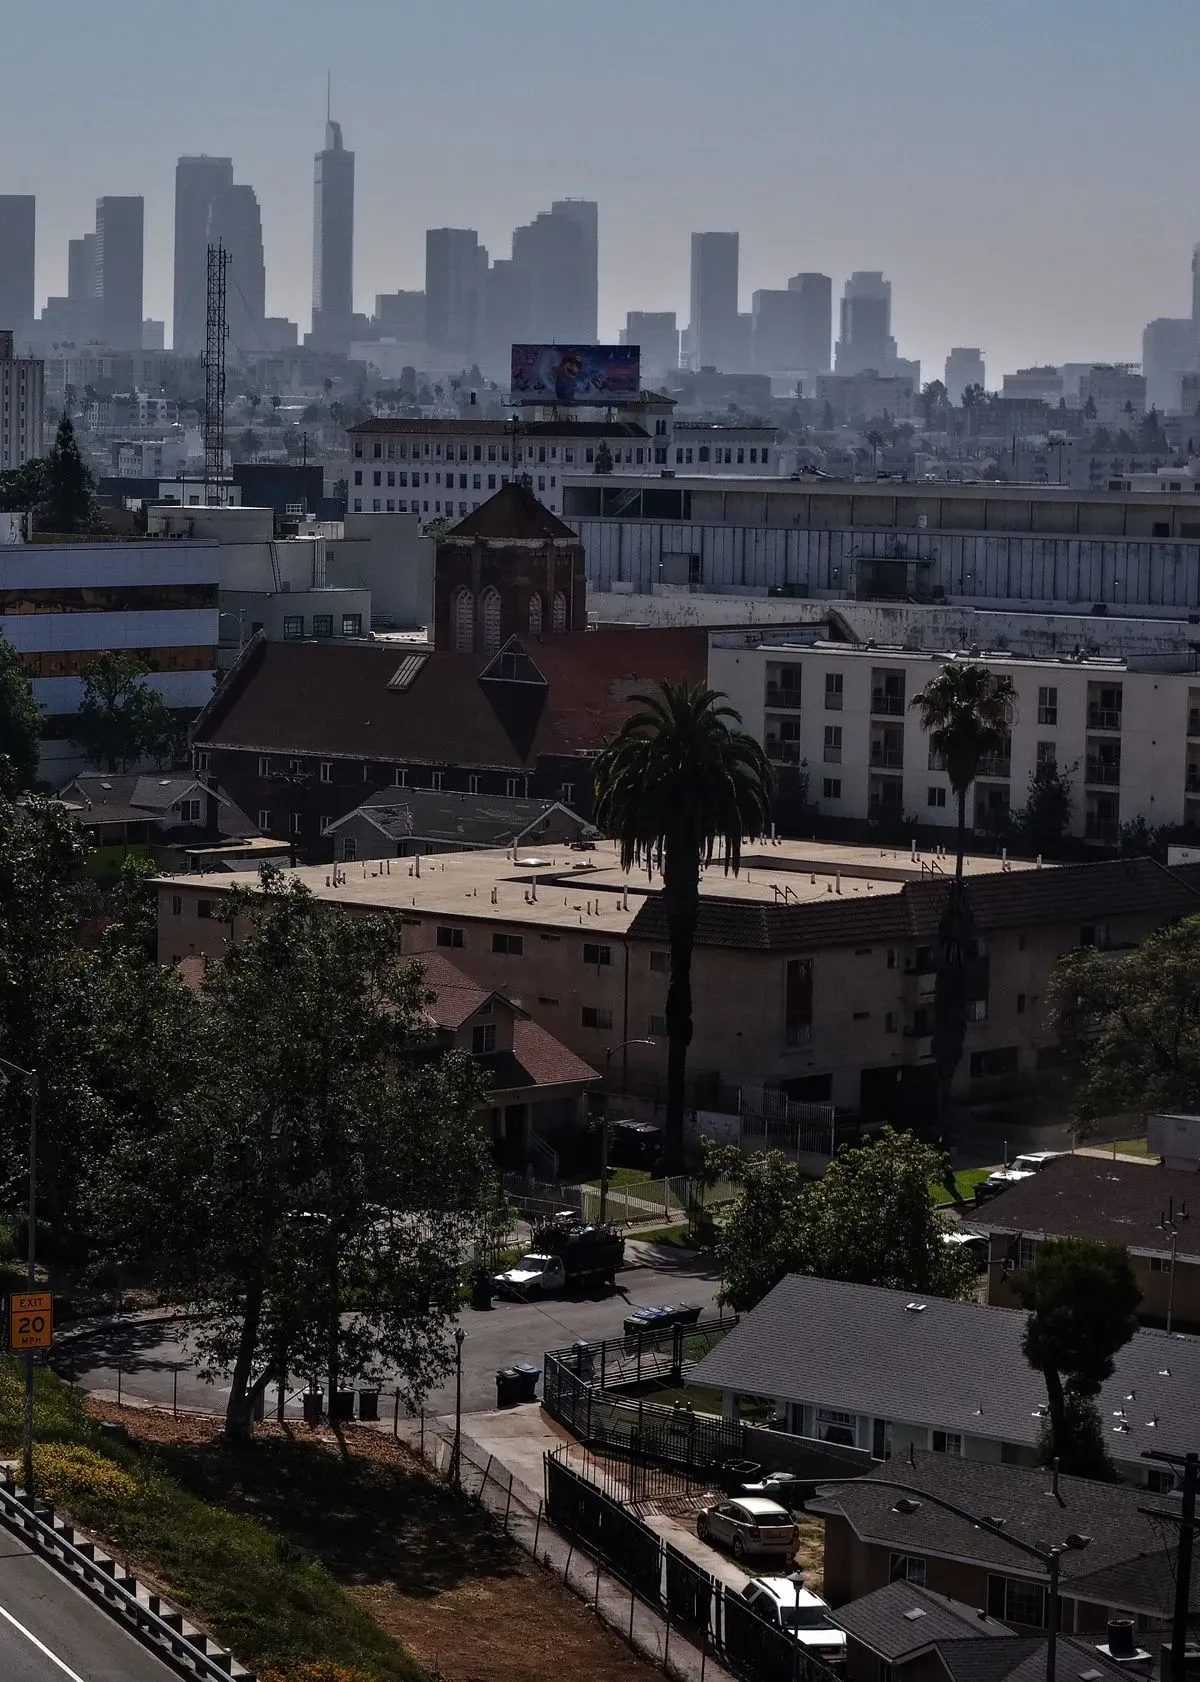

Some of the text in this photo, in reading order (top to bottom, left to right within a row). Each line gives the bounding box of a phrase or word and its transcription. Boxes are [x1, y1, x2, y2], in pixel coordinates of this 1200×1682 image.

[20, 1298, 43, 1307] EXIT
[18, 1317, 44, 1333] 20
[21, 1336, 41, 1345] MPH
